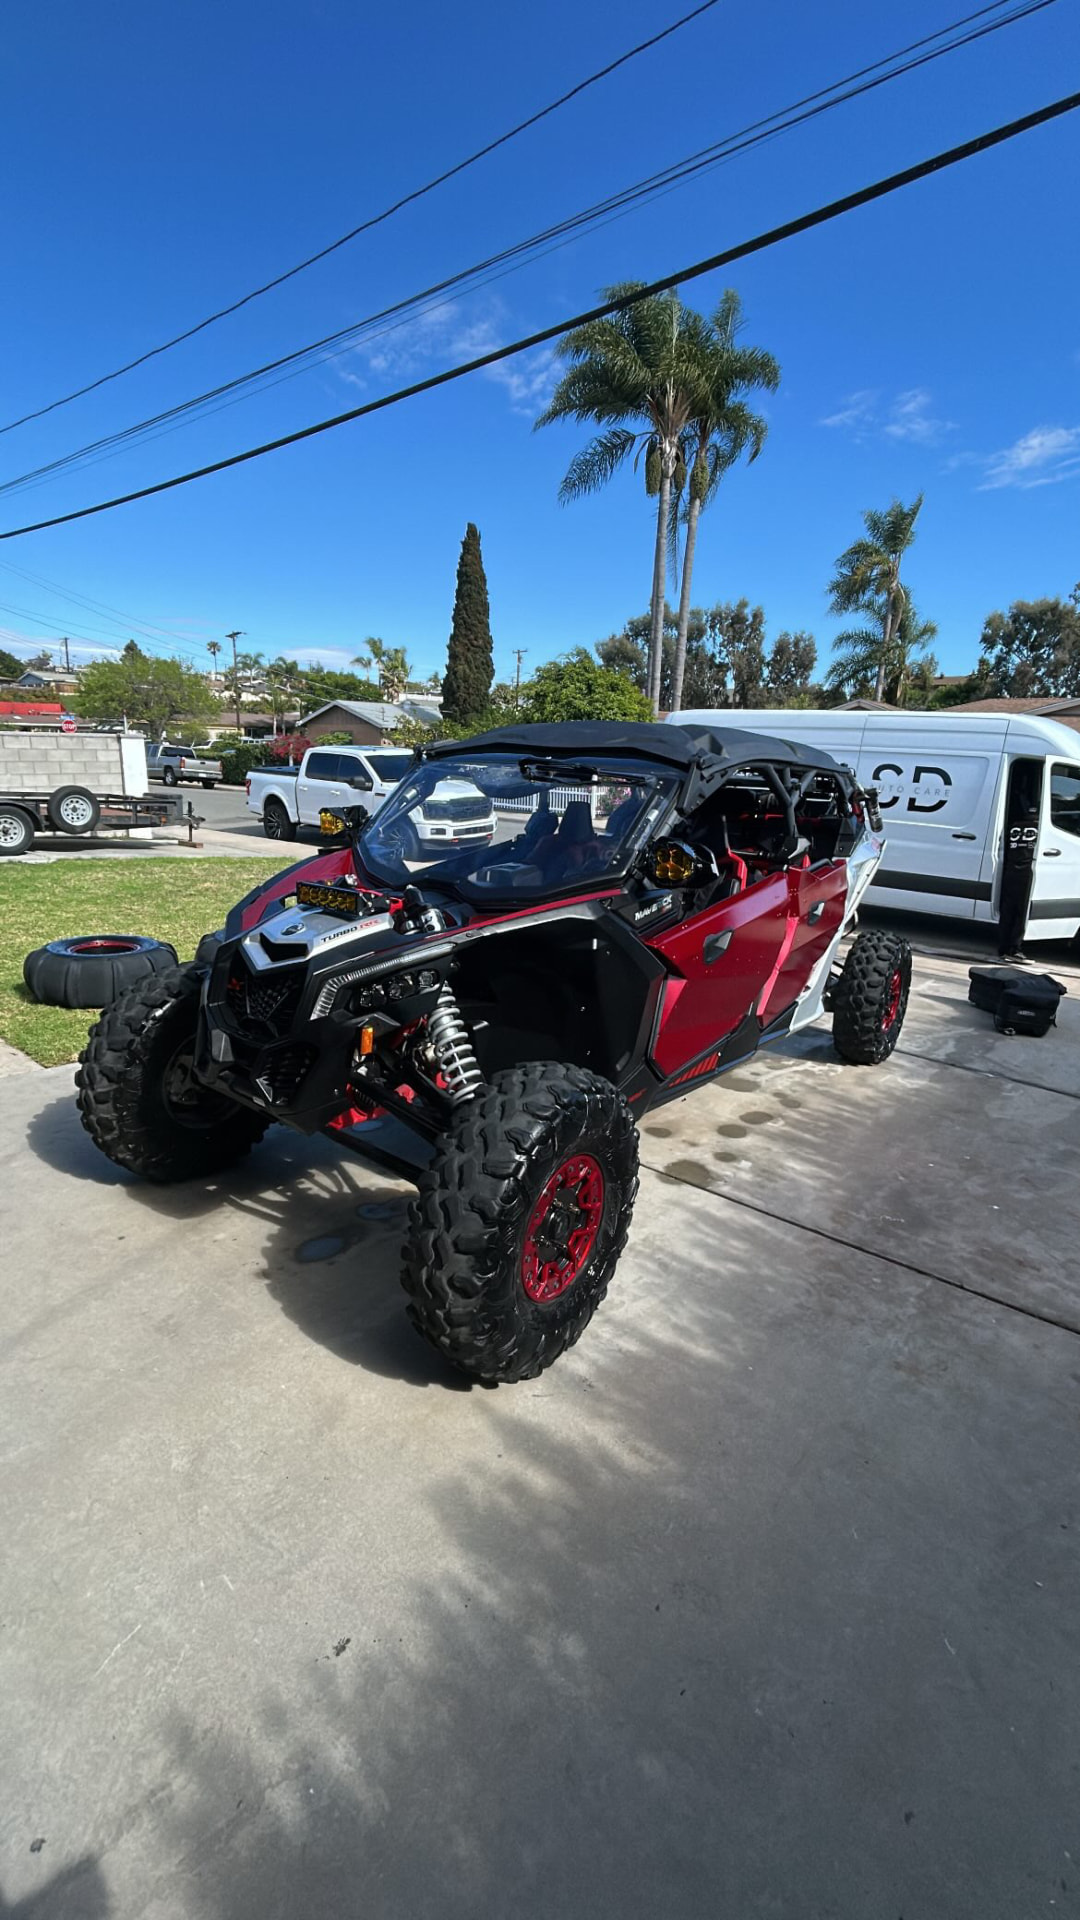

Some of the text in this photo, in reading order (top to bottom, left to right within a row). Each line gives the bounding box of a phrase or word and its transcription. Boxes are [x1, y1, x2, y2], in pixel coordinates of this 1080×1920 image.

[62, 722, 76, 730] STOP
[913, 787, 951, 798] CARE
[320, 926, 358, 943] TURBO
